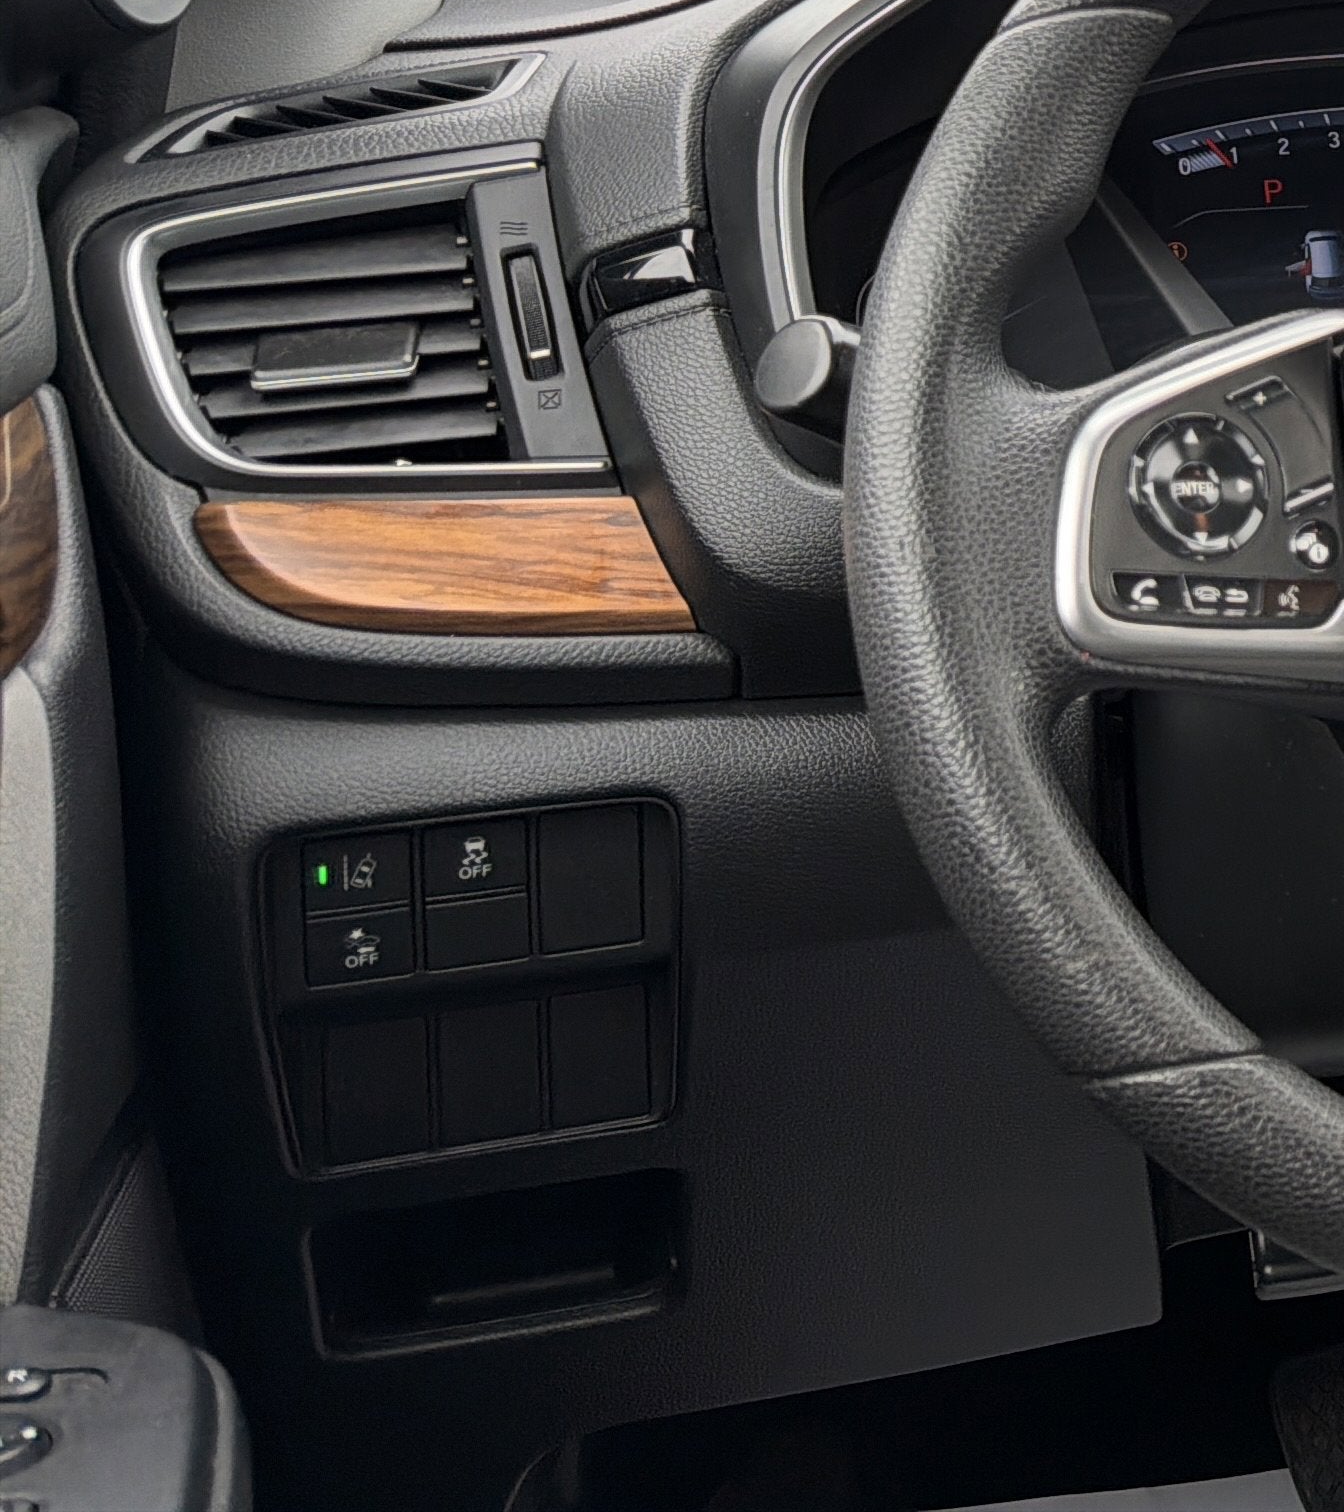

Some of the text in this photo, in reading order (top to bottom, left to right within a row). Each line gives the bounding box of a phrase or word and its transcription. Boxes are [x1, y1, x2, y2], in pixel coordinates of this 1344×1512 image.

[1179, 157, 1191, 175] 0
[1230, 147, 1238, 164] 1
[1278, 138, 1290, 155] 2
[1328, 131, 1341, 149] 3
[1263, 179, 1283, 203] P
[458, 863, 492, 880] OFF
[345, 951, 379, 968] OFF
